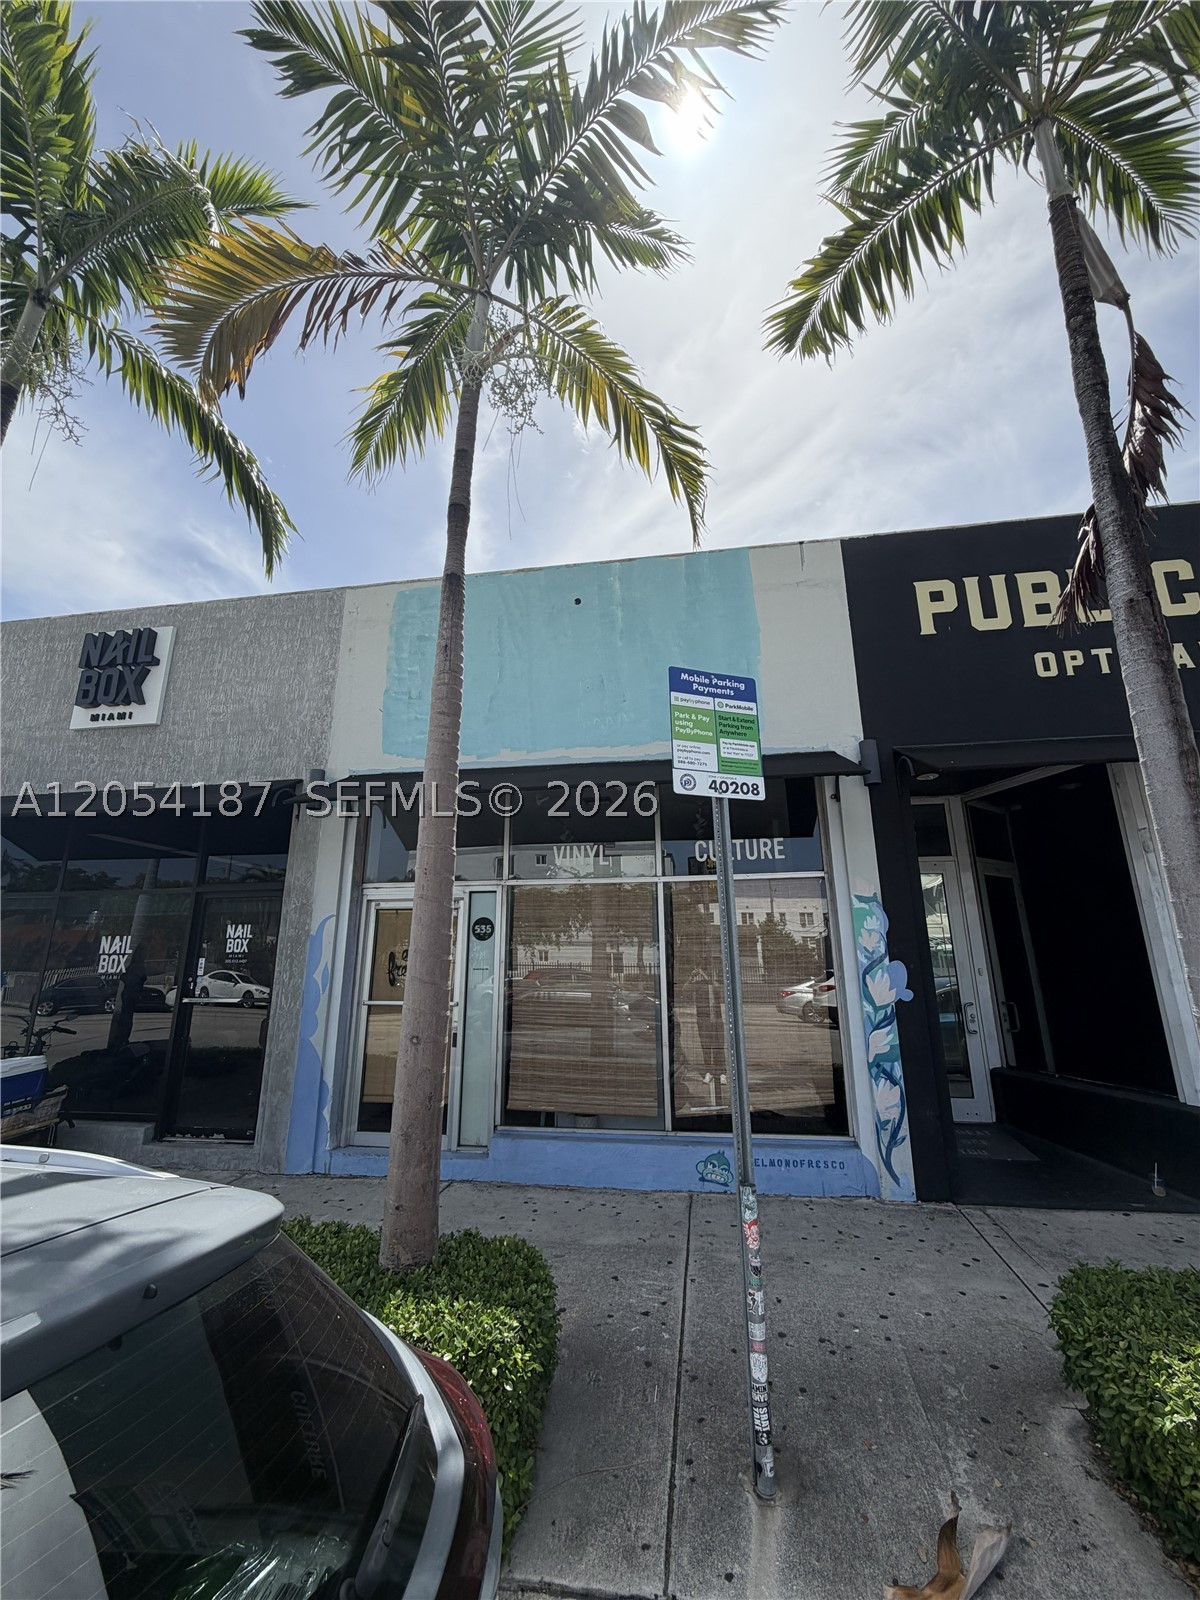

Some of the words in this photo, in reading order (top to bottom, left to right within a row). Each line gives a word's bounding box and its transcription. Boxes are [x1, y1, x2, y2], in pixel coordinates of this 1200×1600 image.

[912, 558, 1200, 636] PUBLC
[78, 627, 161, 670] NAIL
[1033, 641, 1200, 678] OPTA
[75, 664, 151, 709] BOX
[680, 672, 710, 685] Mobile
[712, 678, 745, 690] Parking
[692, 684, 735, 696] Payments
[680, 696, 710, 706] paybyphone
[725, 703, 754, 712] ParkMobile
[90, 711, 133, 722] MIAMI
[674, 712, 690, 720] Park
[698, 714, 710, 723] Pay
[718, 715, 731, 723] Start
[675, 720, 693, 728] using
[719, 722, 740, 731] Parking
[675, 727, 713, 737] PayByPhone
[719, 729, 747, 737] Anywhere
[708, 779, 760, 796] 40208
[553, 844, 609, 866] VINYL
[694, 837, 786, 863] CUTURE
[226, 924, 253, 938] NAIL
[474, 924, 492, 934] 535
[98, 935, 133, 954] NAIL
[225, 938, 250, 953] BOX
[97, 954, 128, 974] BOX
[754, 1158, 846, 1171] ELMONOFRESCO
